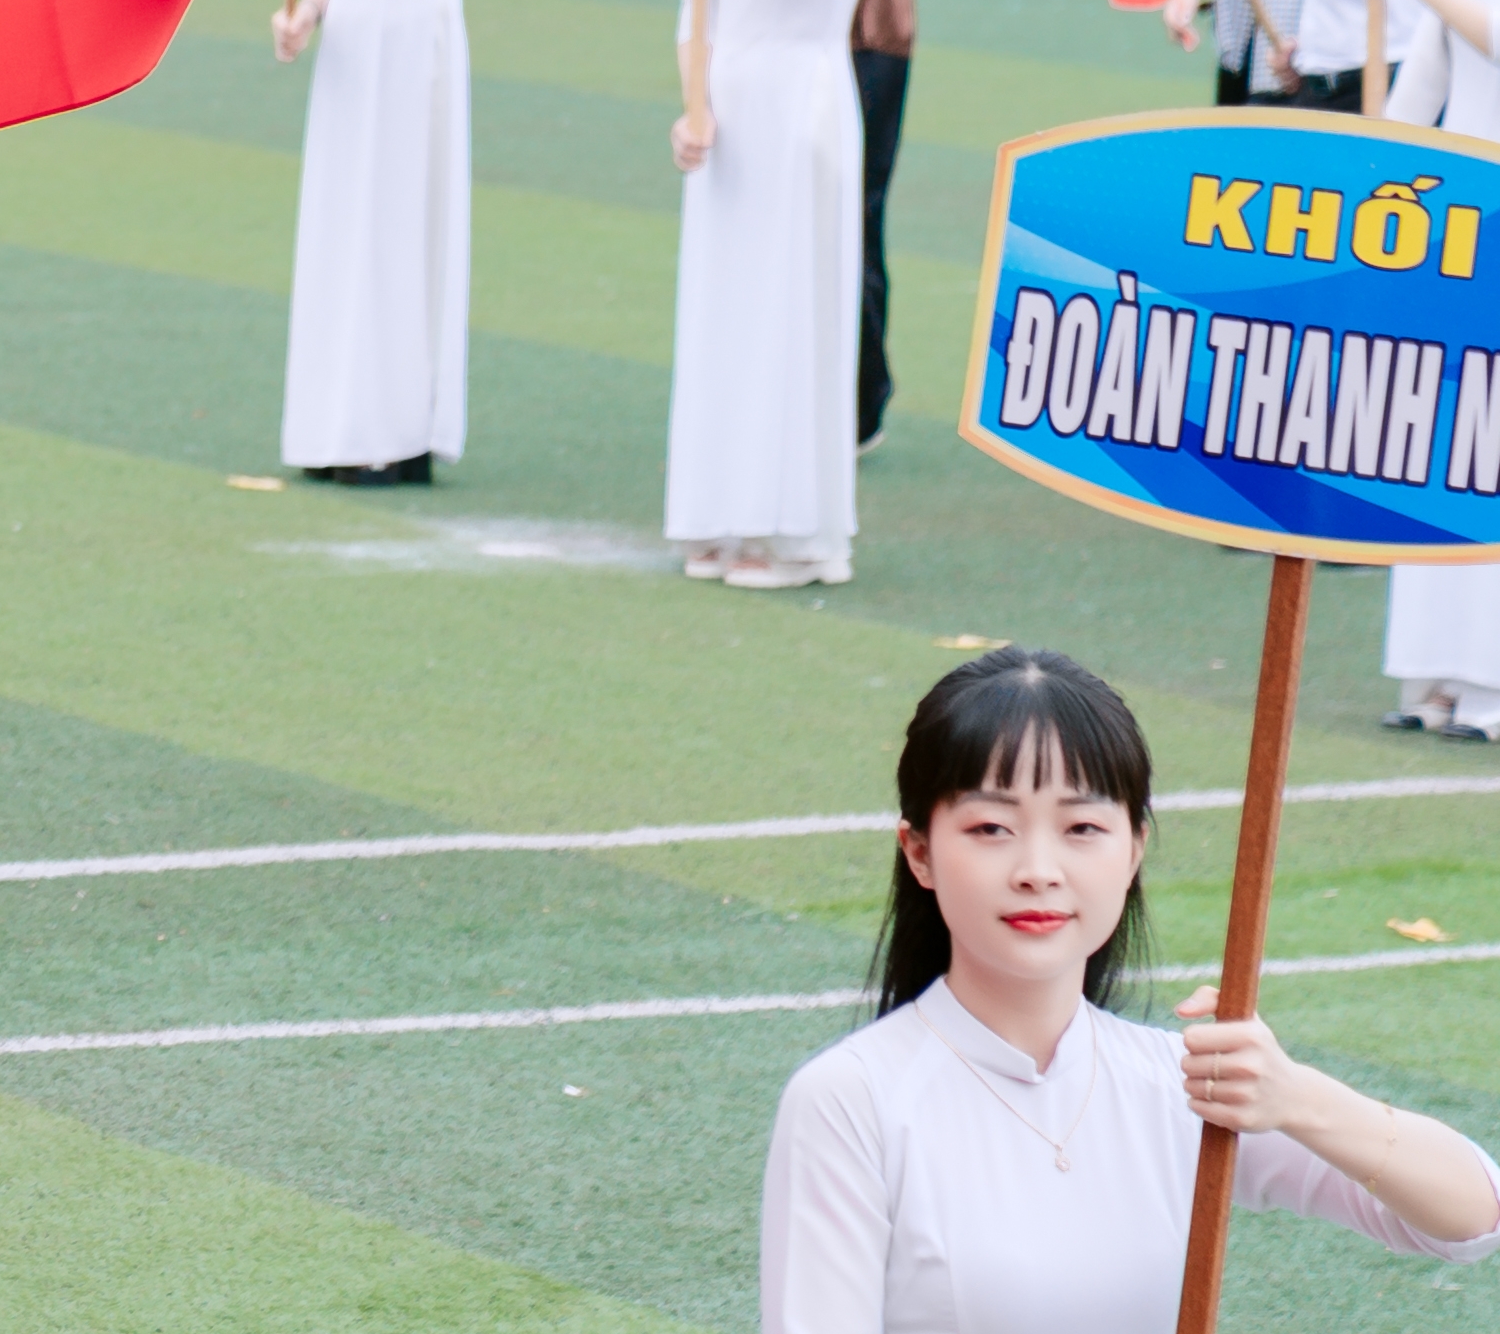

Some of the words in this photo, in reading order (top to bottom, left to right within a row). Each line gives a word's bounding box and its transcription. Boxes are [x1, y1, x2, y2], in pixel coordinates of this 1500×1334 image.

[1184, 175, 1482, 279] KHỐI
[999, 270, 1198, 450] ĐOÀN
[1202, 313, 1445, 487] THANH
